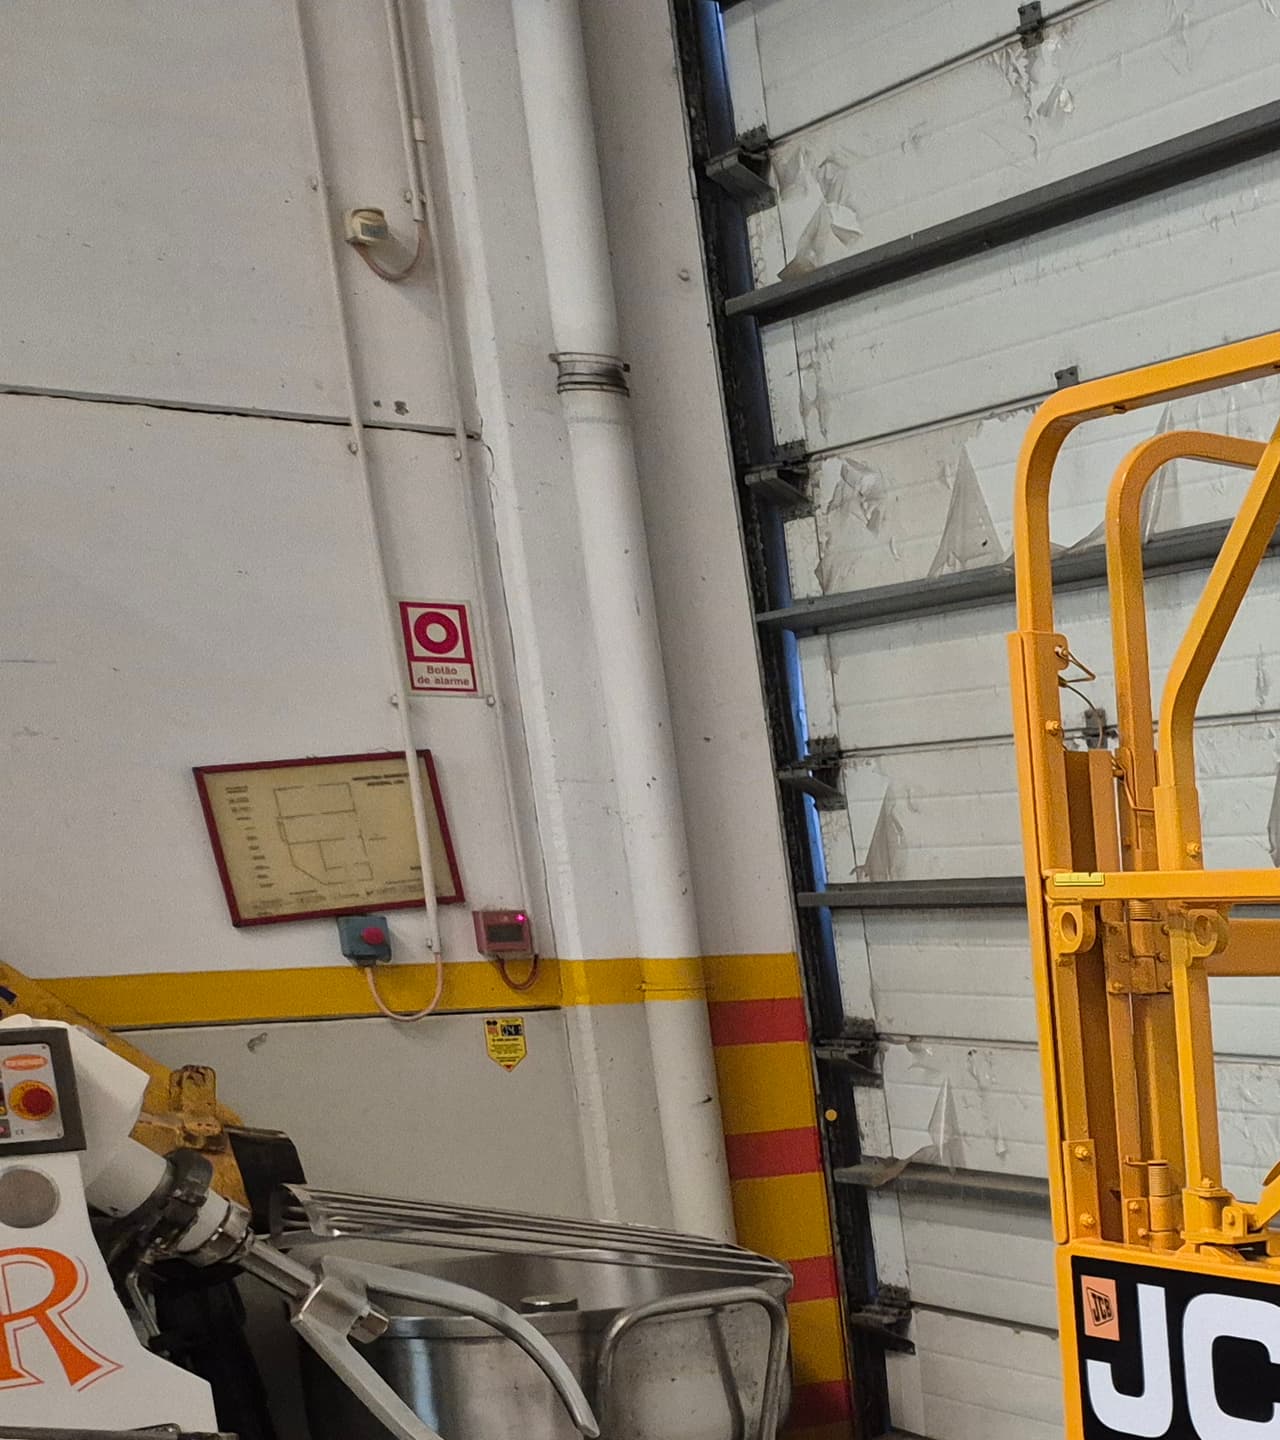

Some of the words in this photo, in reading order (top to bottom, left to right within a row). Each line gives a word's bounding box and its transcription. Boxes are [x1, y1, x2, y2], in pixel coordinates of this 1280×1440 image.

[417, 676, 430, 685] de
[434, 677, 470, 686] alarme
[1091, 1291, 1112, 1322] JCB
